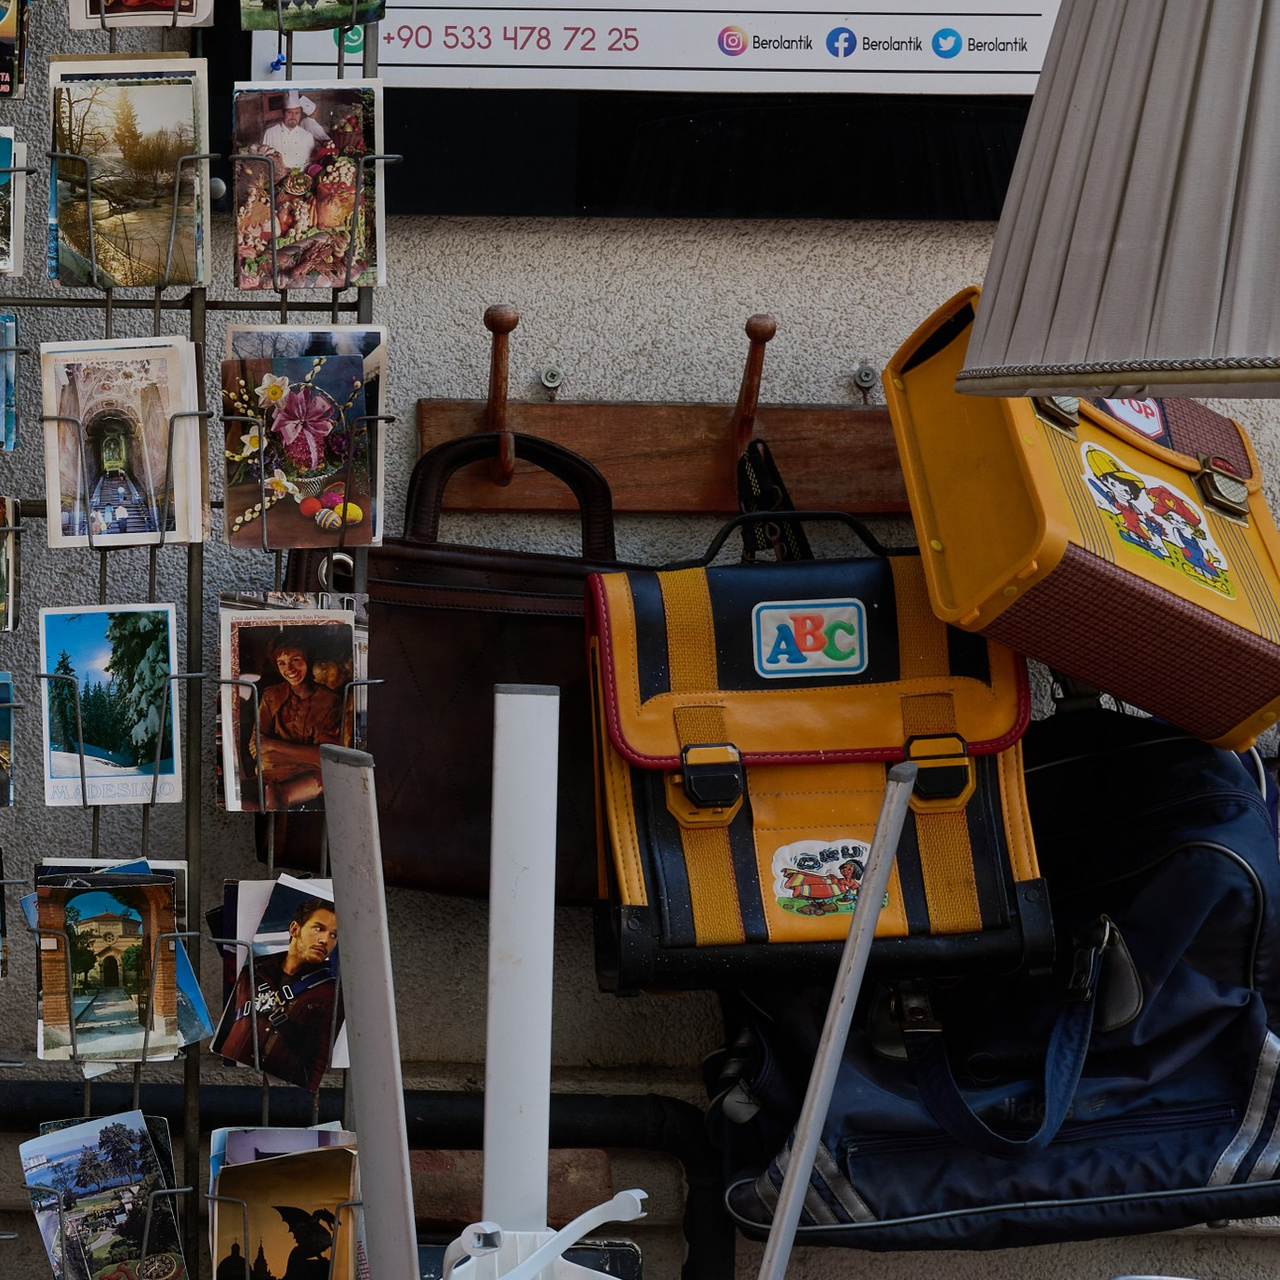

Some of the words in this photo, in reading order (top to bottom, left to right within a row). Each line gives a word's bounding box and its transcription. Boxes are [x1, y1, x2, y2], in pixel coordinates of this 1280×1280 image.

[383, 24, 433, 49] +90
[443, 25, 492, 51] 533
[503, 25, 551, 51] 478
[564, 26, 596, 52] 72
[608, 26, 640, 52] 25
[752, 34, 813, 51] Berolantik
[862, 36, 923, 52] Berolantik
[967, 36, 1028, 53] Berolantik
[766, 613, 856, 664] ABC
